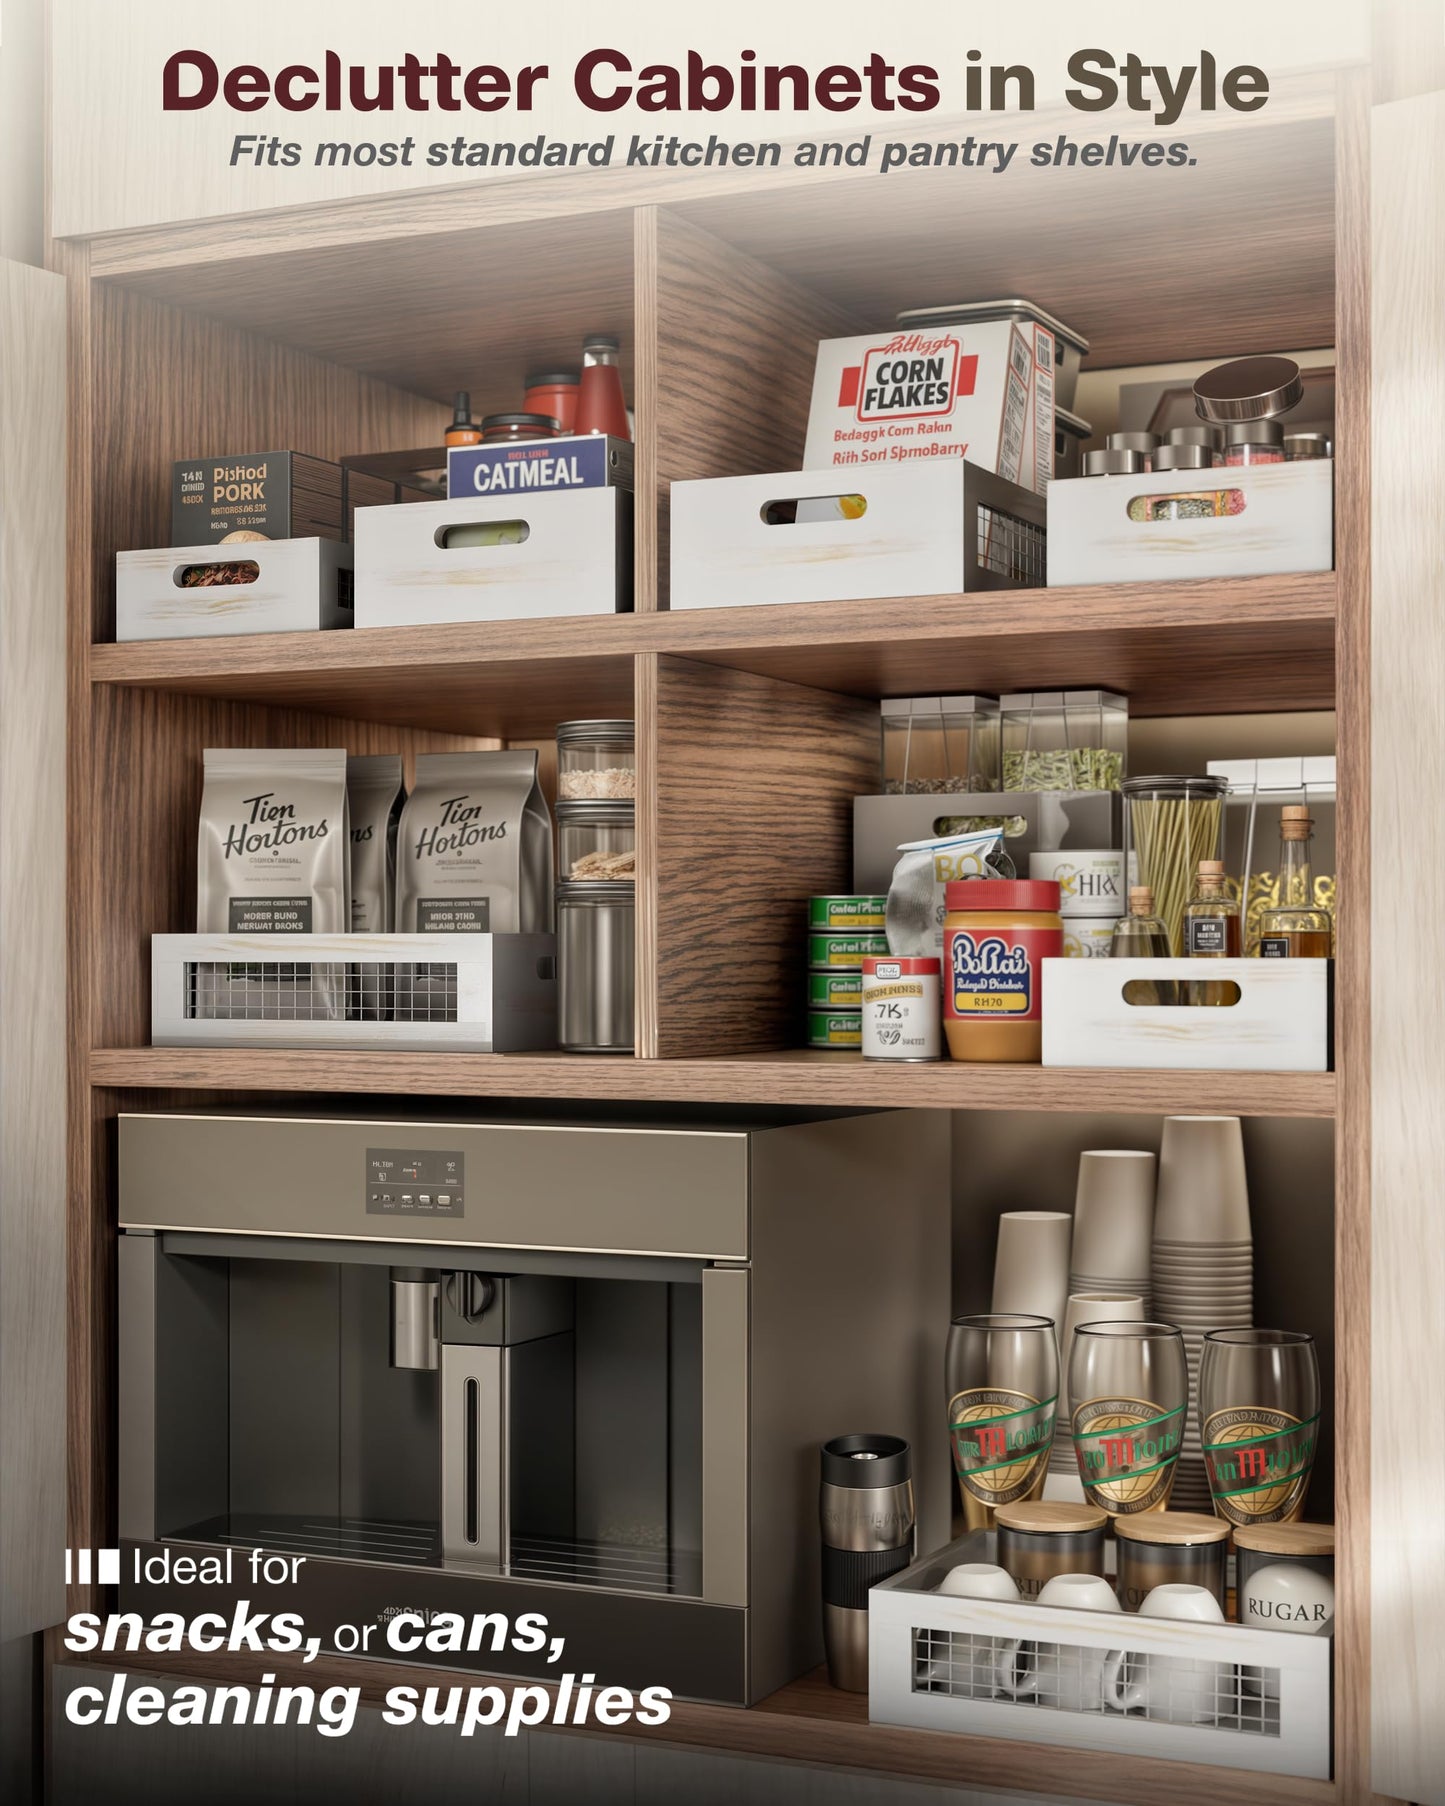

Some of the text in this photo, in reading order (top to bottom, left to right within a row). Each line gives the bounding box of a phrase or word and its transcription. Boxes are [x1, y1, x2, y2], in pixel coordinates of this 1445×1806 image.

[876, 357, 944, 386] CORN
[864, 381, 949, 411] FLAKES
[473, 456, 585, 492] CATMEAL
[213, 481, 265, 503] PORK
[222, 819, 329, 859] Hortons
[415, 821, 507, 860] Hortons
[1249, 1598, 1328, 1622] RUGAR
